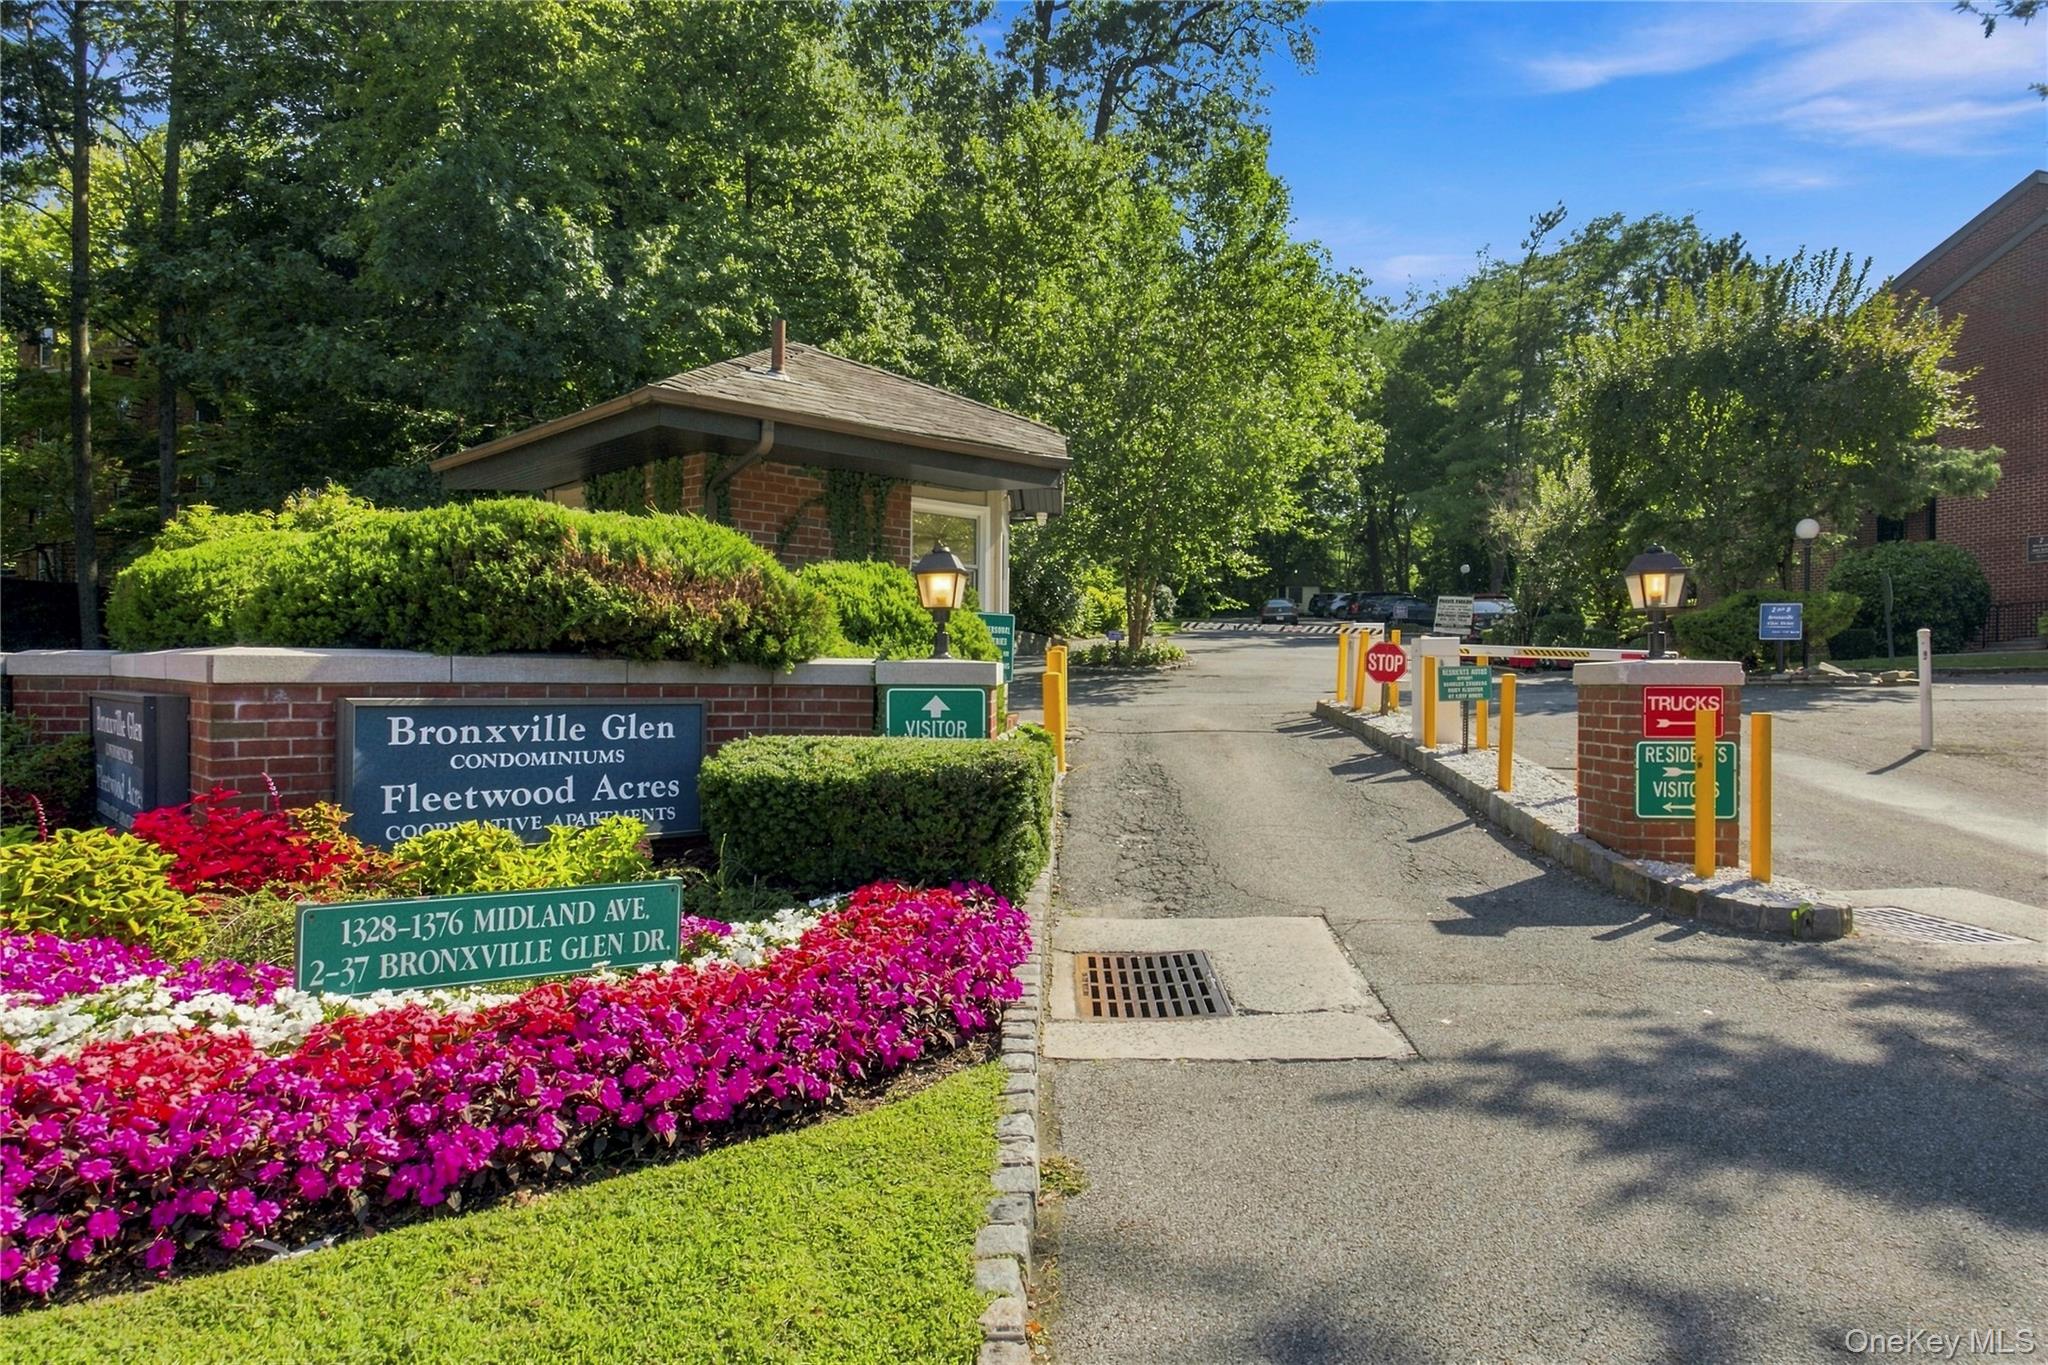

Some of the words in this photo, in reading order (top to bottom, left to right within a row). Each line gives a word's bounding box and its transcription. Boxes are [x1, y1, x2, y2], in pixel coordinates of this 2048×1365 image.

[1368, 652, 1404, 672] STOP
[1647, 695, 1720, 711] TRUCKS
[386, 713, 586, 746] Bronxville
[601, 712, 676, 740] Glen
[905, 720, 968, 738] VISITOR
[449, 749, 625, 770] CONDOMINIUMS
[1645, 746, 1728, 764] RESIDES
[381, 775, 576, 814] Fleetwood
[591, 773, 680, 802] Acres
[1653, 781, 1720, 798] VISITOS
[340, 907, 464, 949] 1328-1376
[474, 899, 596, 934] MIDLAND
[604, 897, 650, 923] AVE.
[309, 956, 368, 987] 2-37
[378, 938, 552, 980] BRONXVILLE
[561, 932, 625, 962] GLEN
[632, 928, 671, 954] DR.
